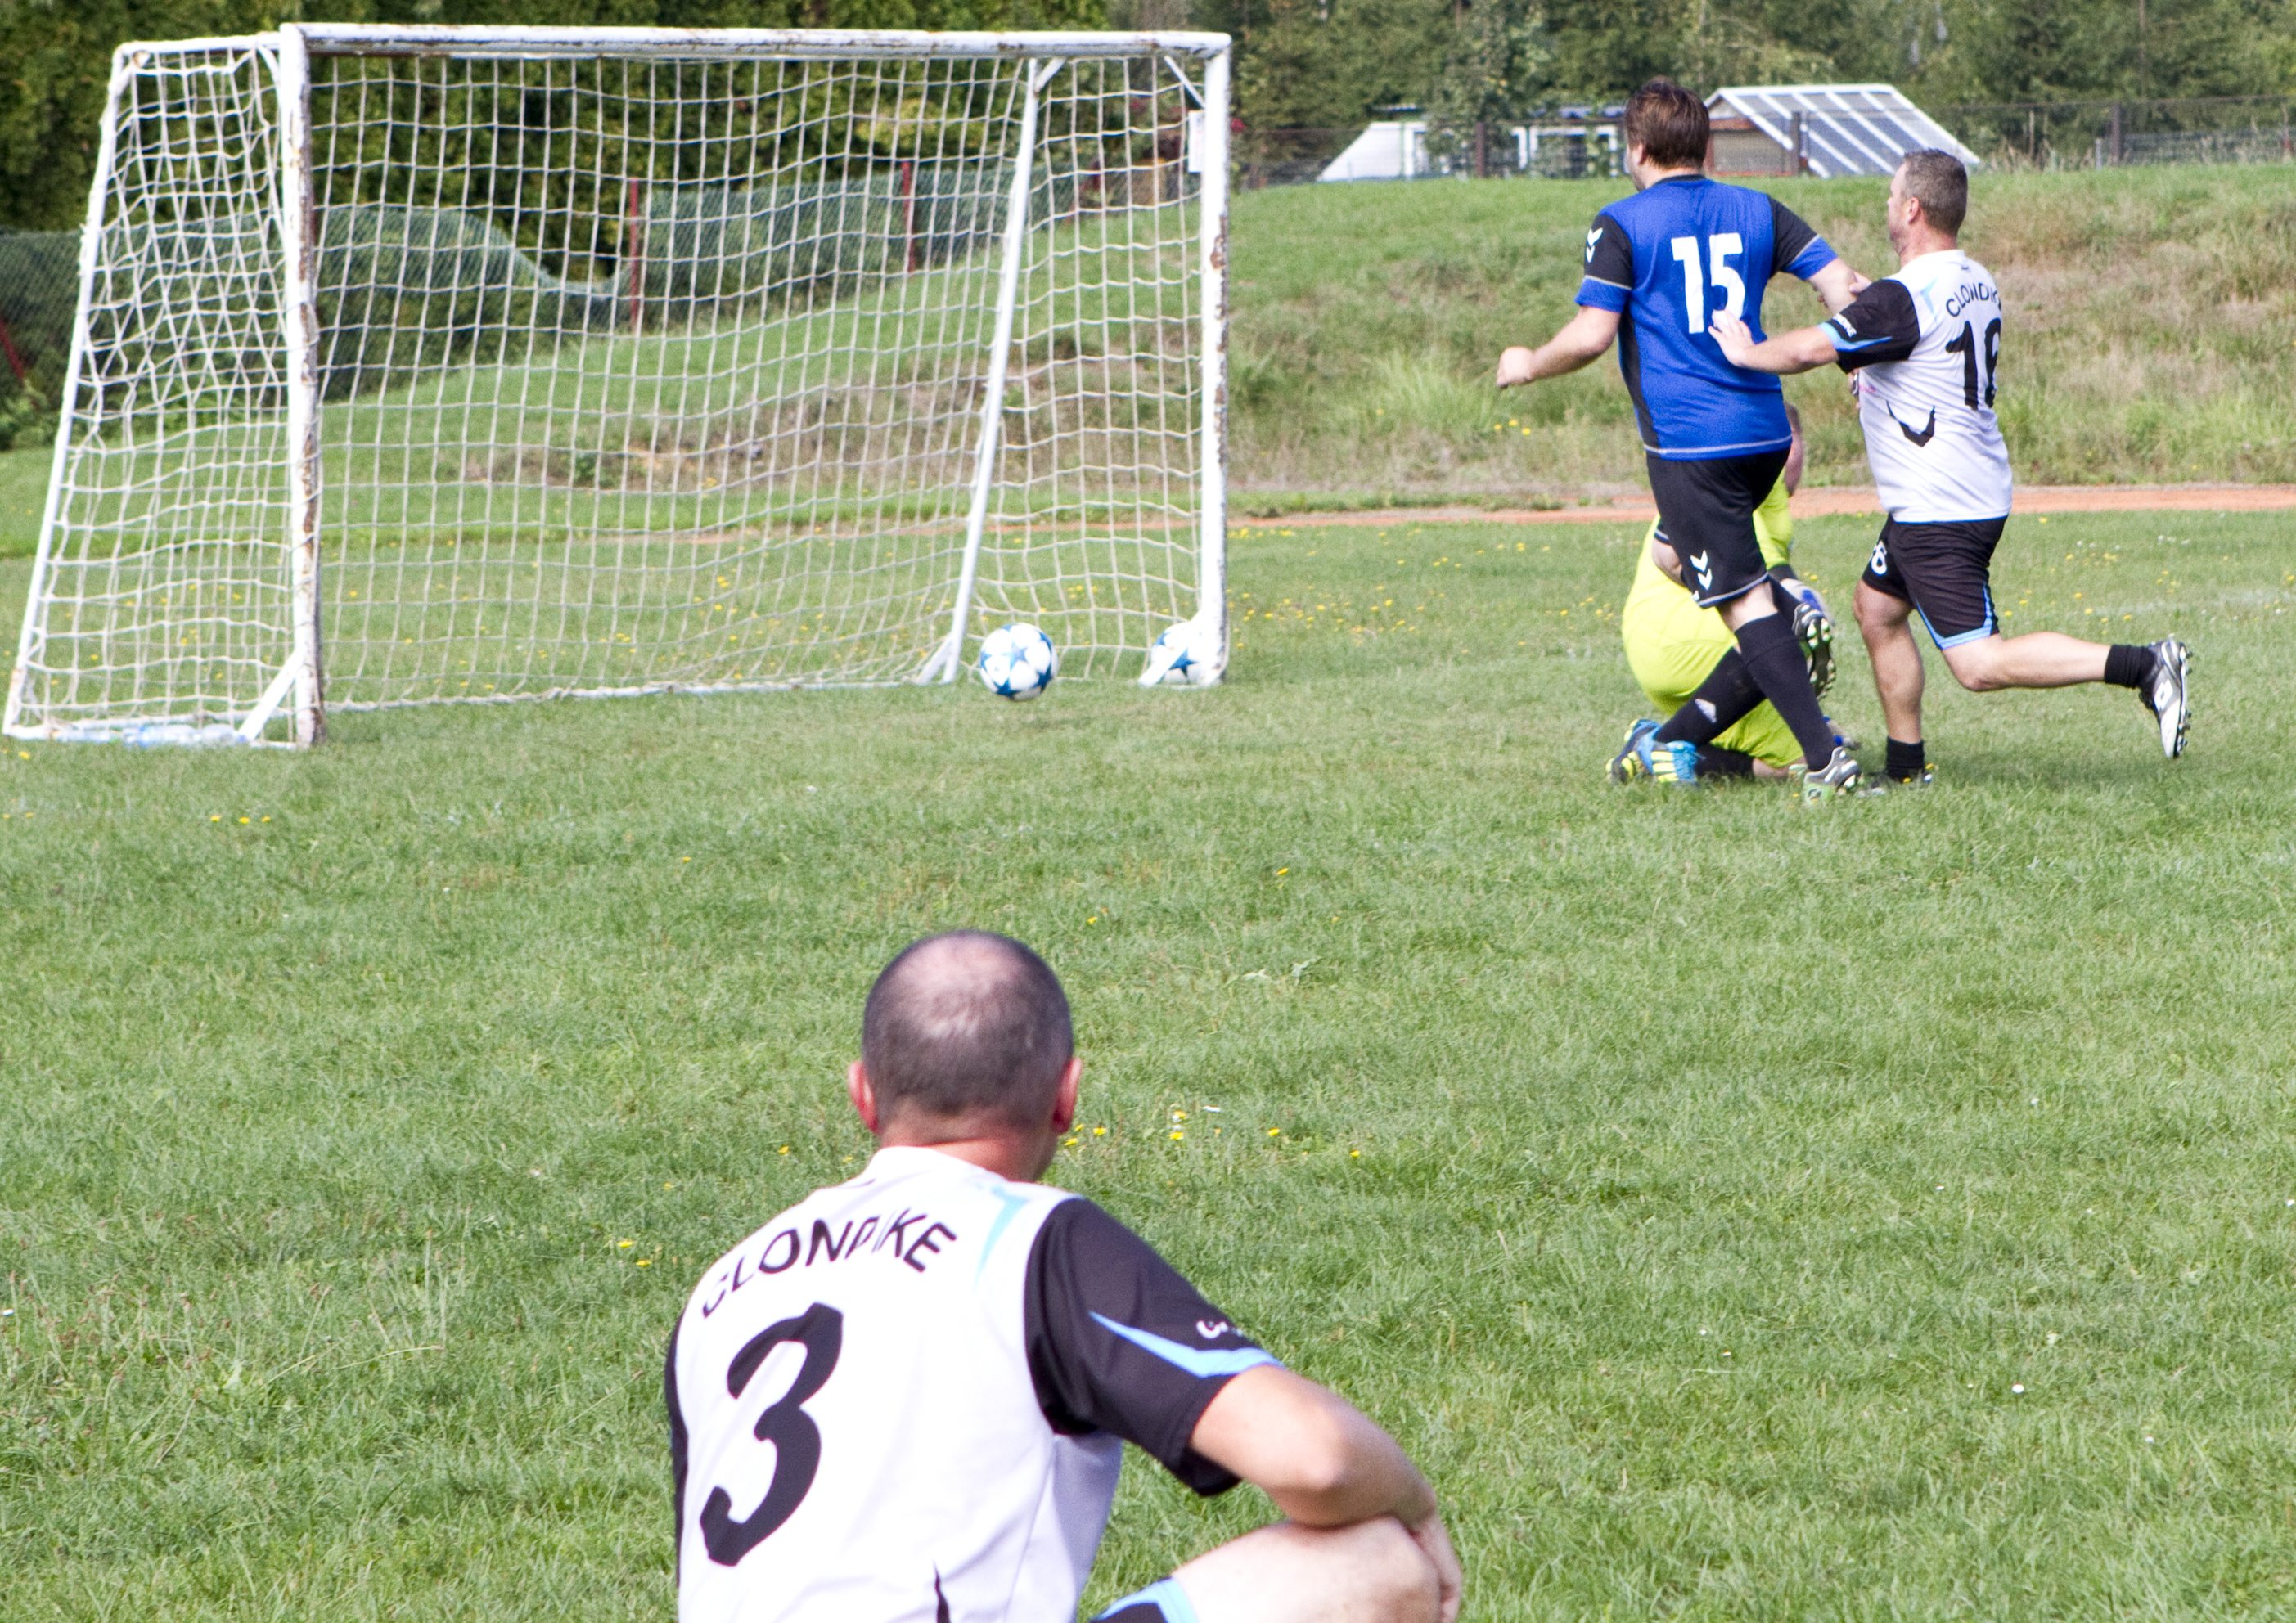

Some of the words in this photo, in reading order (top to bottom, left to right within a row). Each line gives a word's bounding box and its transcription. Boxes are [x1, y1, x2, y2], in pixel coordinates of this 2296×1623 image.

[1671, 232, 1745, 334] 15
[701, 1207, 957, 1319] CLONDIKE
[700, 1302, 844, 1567] 3
